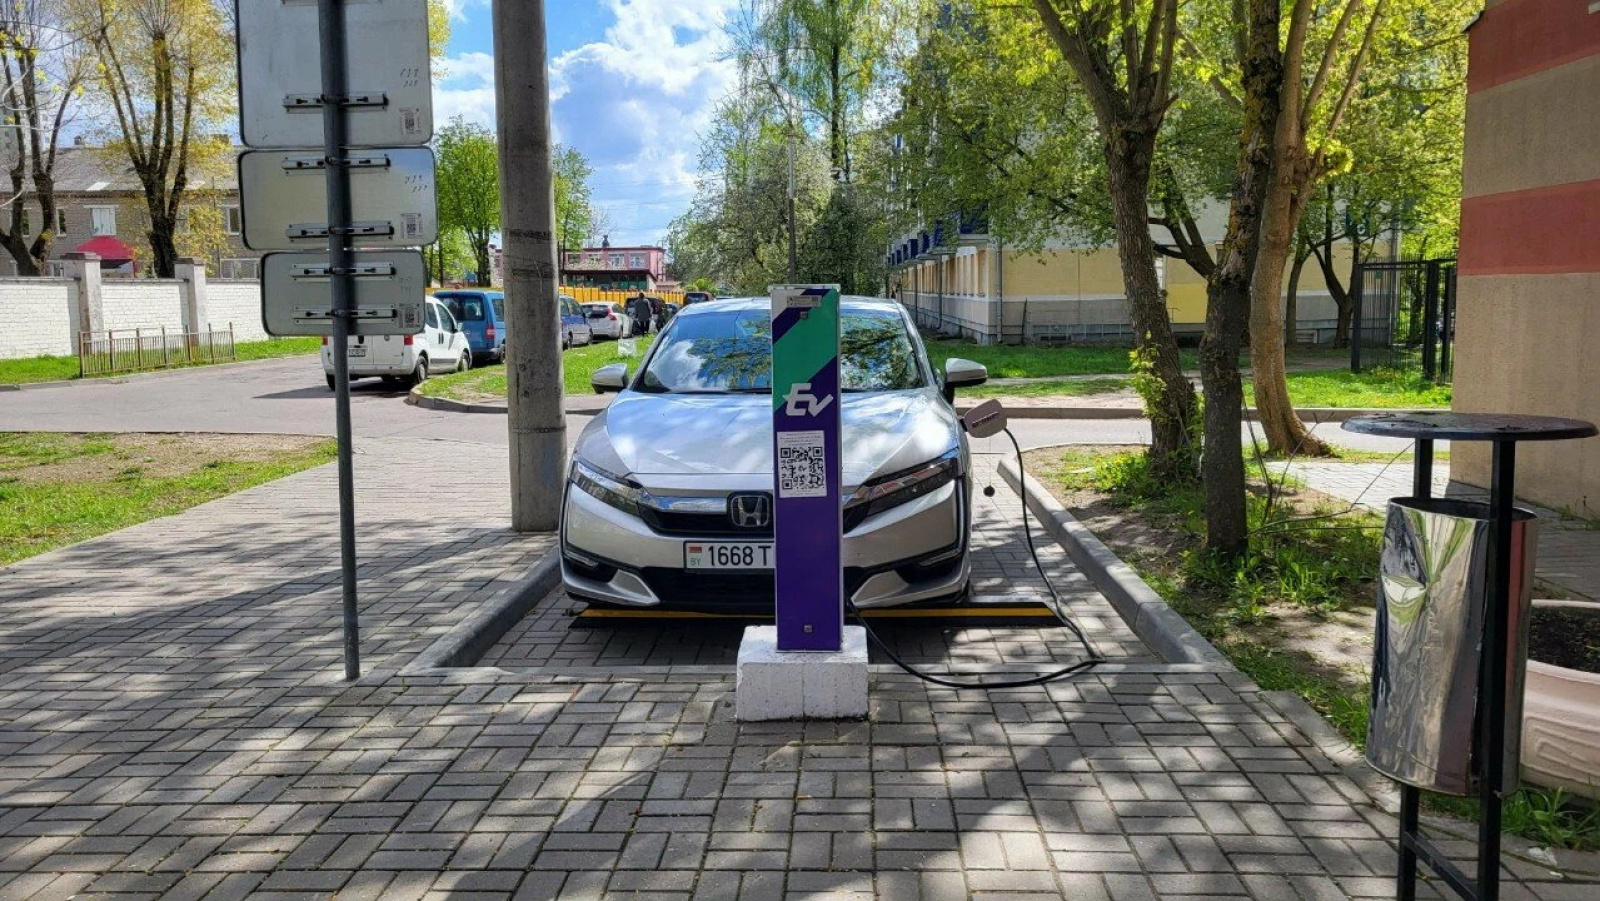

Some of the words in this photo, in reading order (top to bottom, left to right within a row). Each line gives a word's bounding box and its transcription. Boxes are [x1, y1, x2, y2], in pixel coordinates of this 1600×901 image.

[783, 382, 834, 417] Ev
[690, 557, 701, 566] BY
[707, 545, 754, 566] 1668
